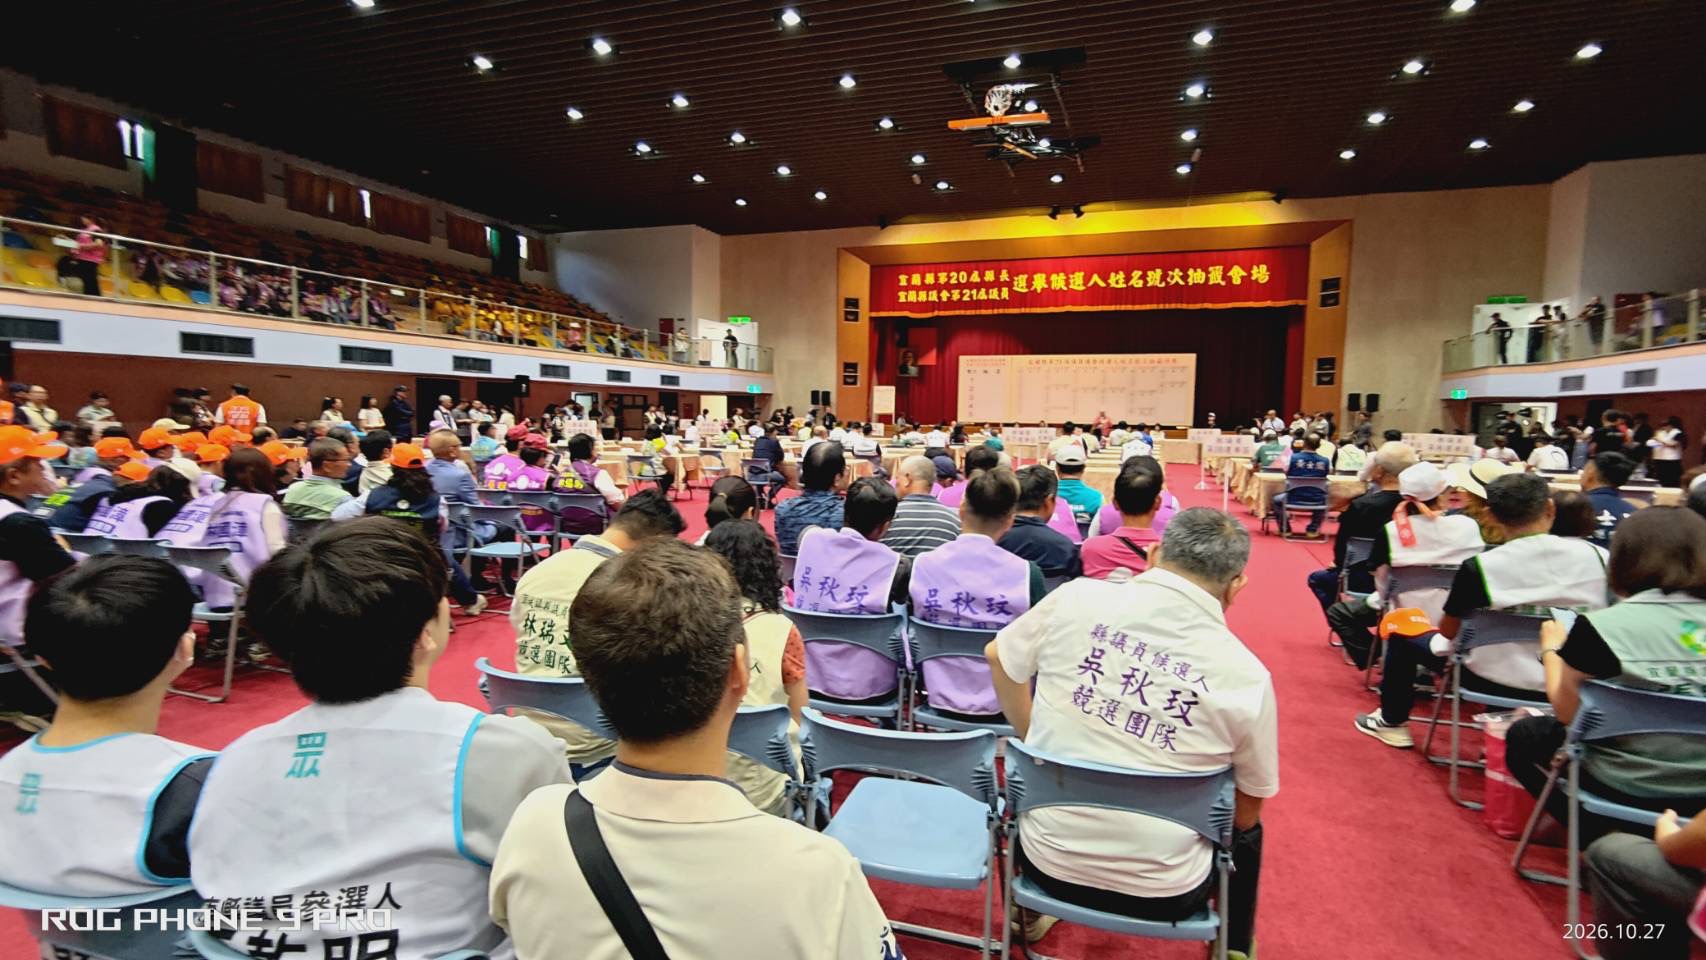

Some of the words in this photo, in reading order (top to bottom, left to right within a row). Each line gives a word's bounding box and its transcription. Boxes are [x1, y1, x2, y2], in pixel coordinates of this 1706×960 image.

[923, 588, 1014, 616] 吳秋玟
[1077, 646, 1199, 727] 吳秋玟
[1090, 623, 1210, 693] 縣議員候選人
[1072, 684, 1177, 752] 競選團隊
